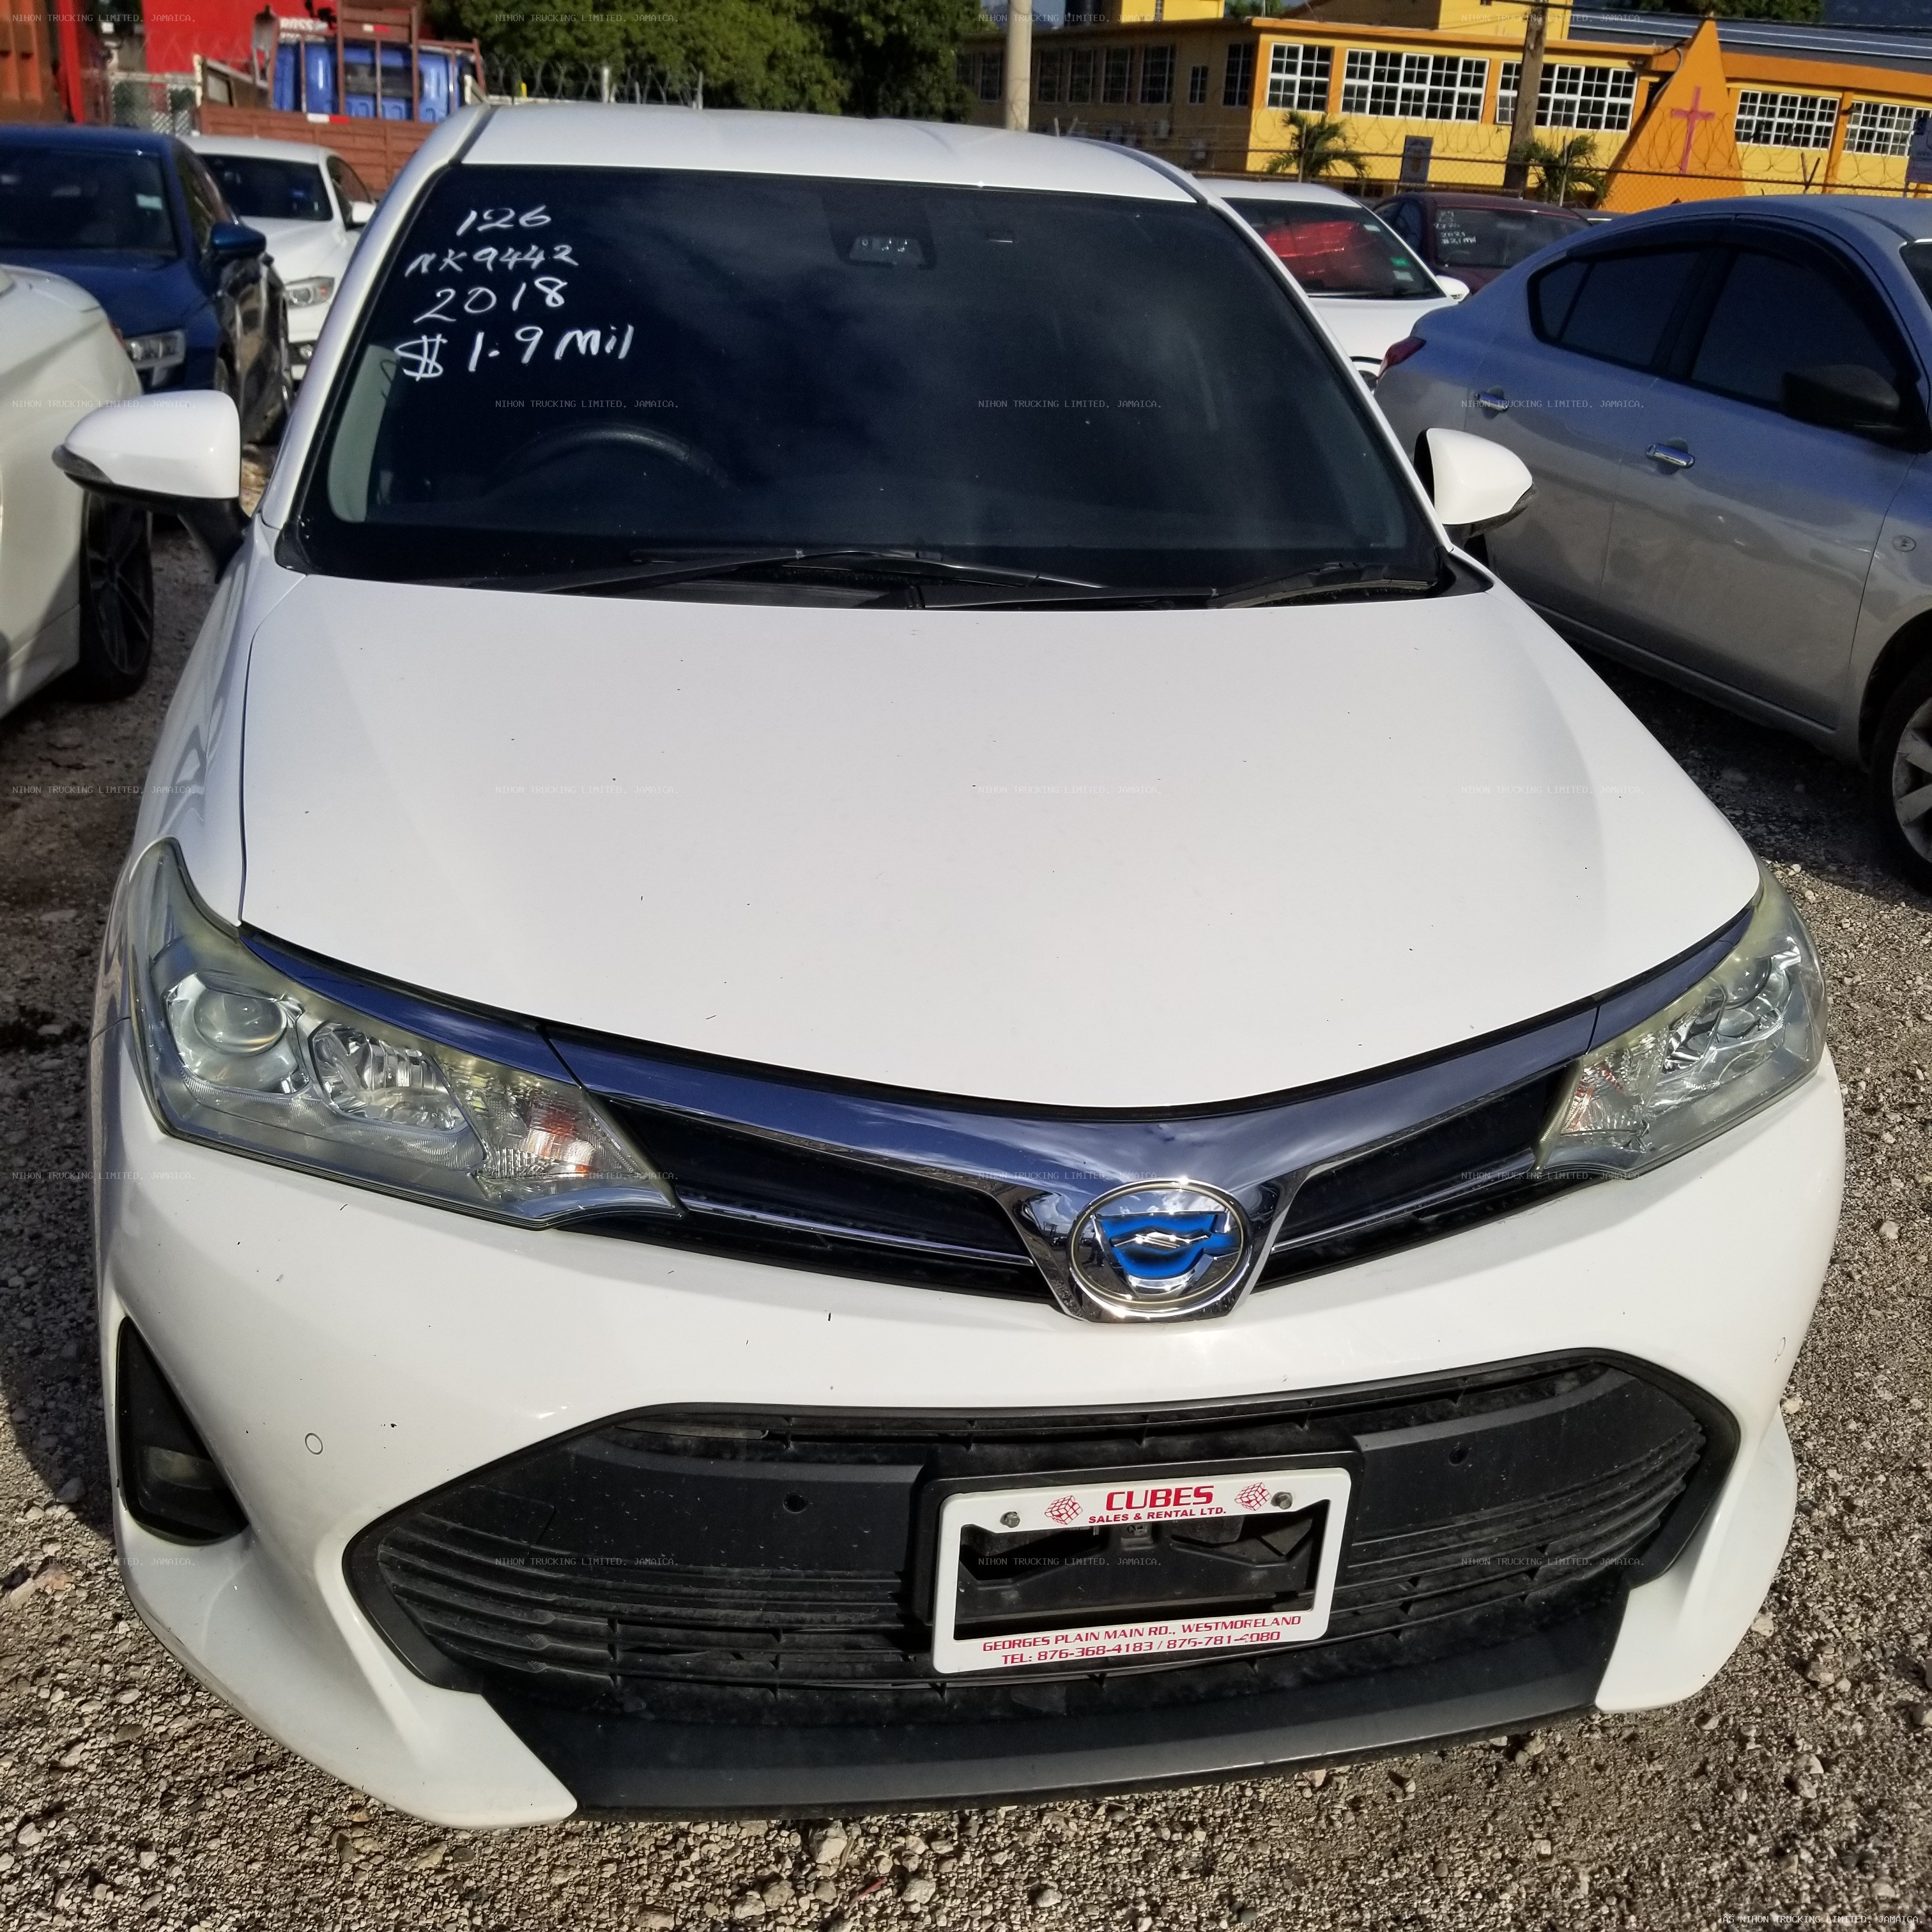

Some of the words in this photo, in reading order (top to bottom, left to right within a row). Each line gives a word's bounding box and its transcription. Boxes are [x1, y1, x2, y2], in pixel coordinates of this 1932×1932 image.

[456, 205, 551, 236] 126
[413, 277, 568, 323] 2018
[1106, 1485, 1214, 1511] CUBES
[1089, 1514, 1129, 1523] SALES
[1147, 1509, 1195, 1519] RENTAL
[1200, 1506, 1226, 1515] LTD.
[983, 1636, 1050, 1652] GEORGES
[1055, 1631, 1100, 1644] PLAIN
[1104, 1627, 1144, 1640] MAIN
[1149, 1626, 1176, 1636] RD.,
[1182, 1616, 1301, 1634] WESTMORELAND
[1002, 1653, 1032, 1665] TEL:
[1038, 1642, 1153, 1661] 876-368-4183
[1157, 1640, 1163, 1650] /
